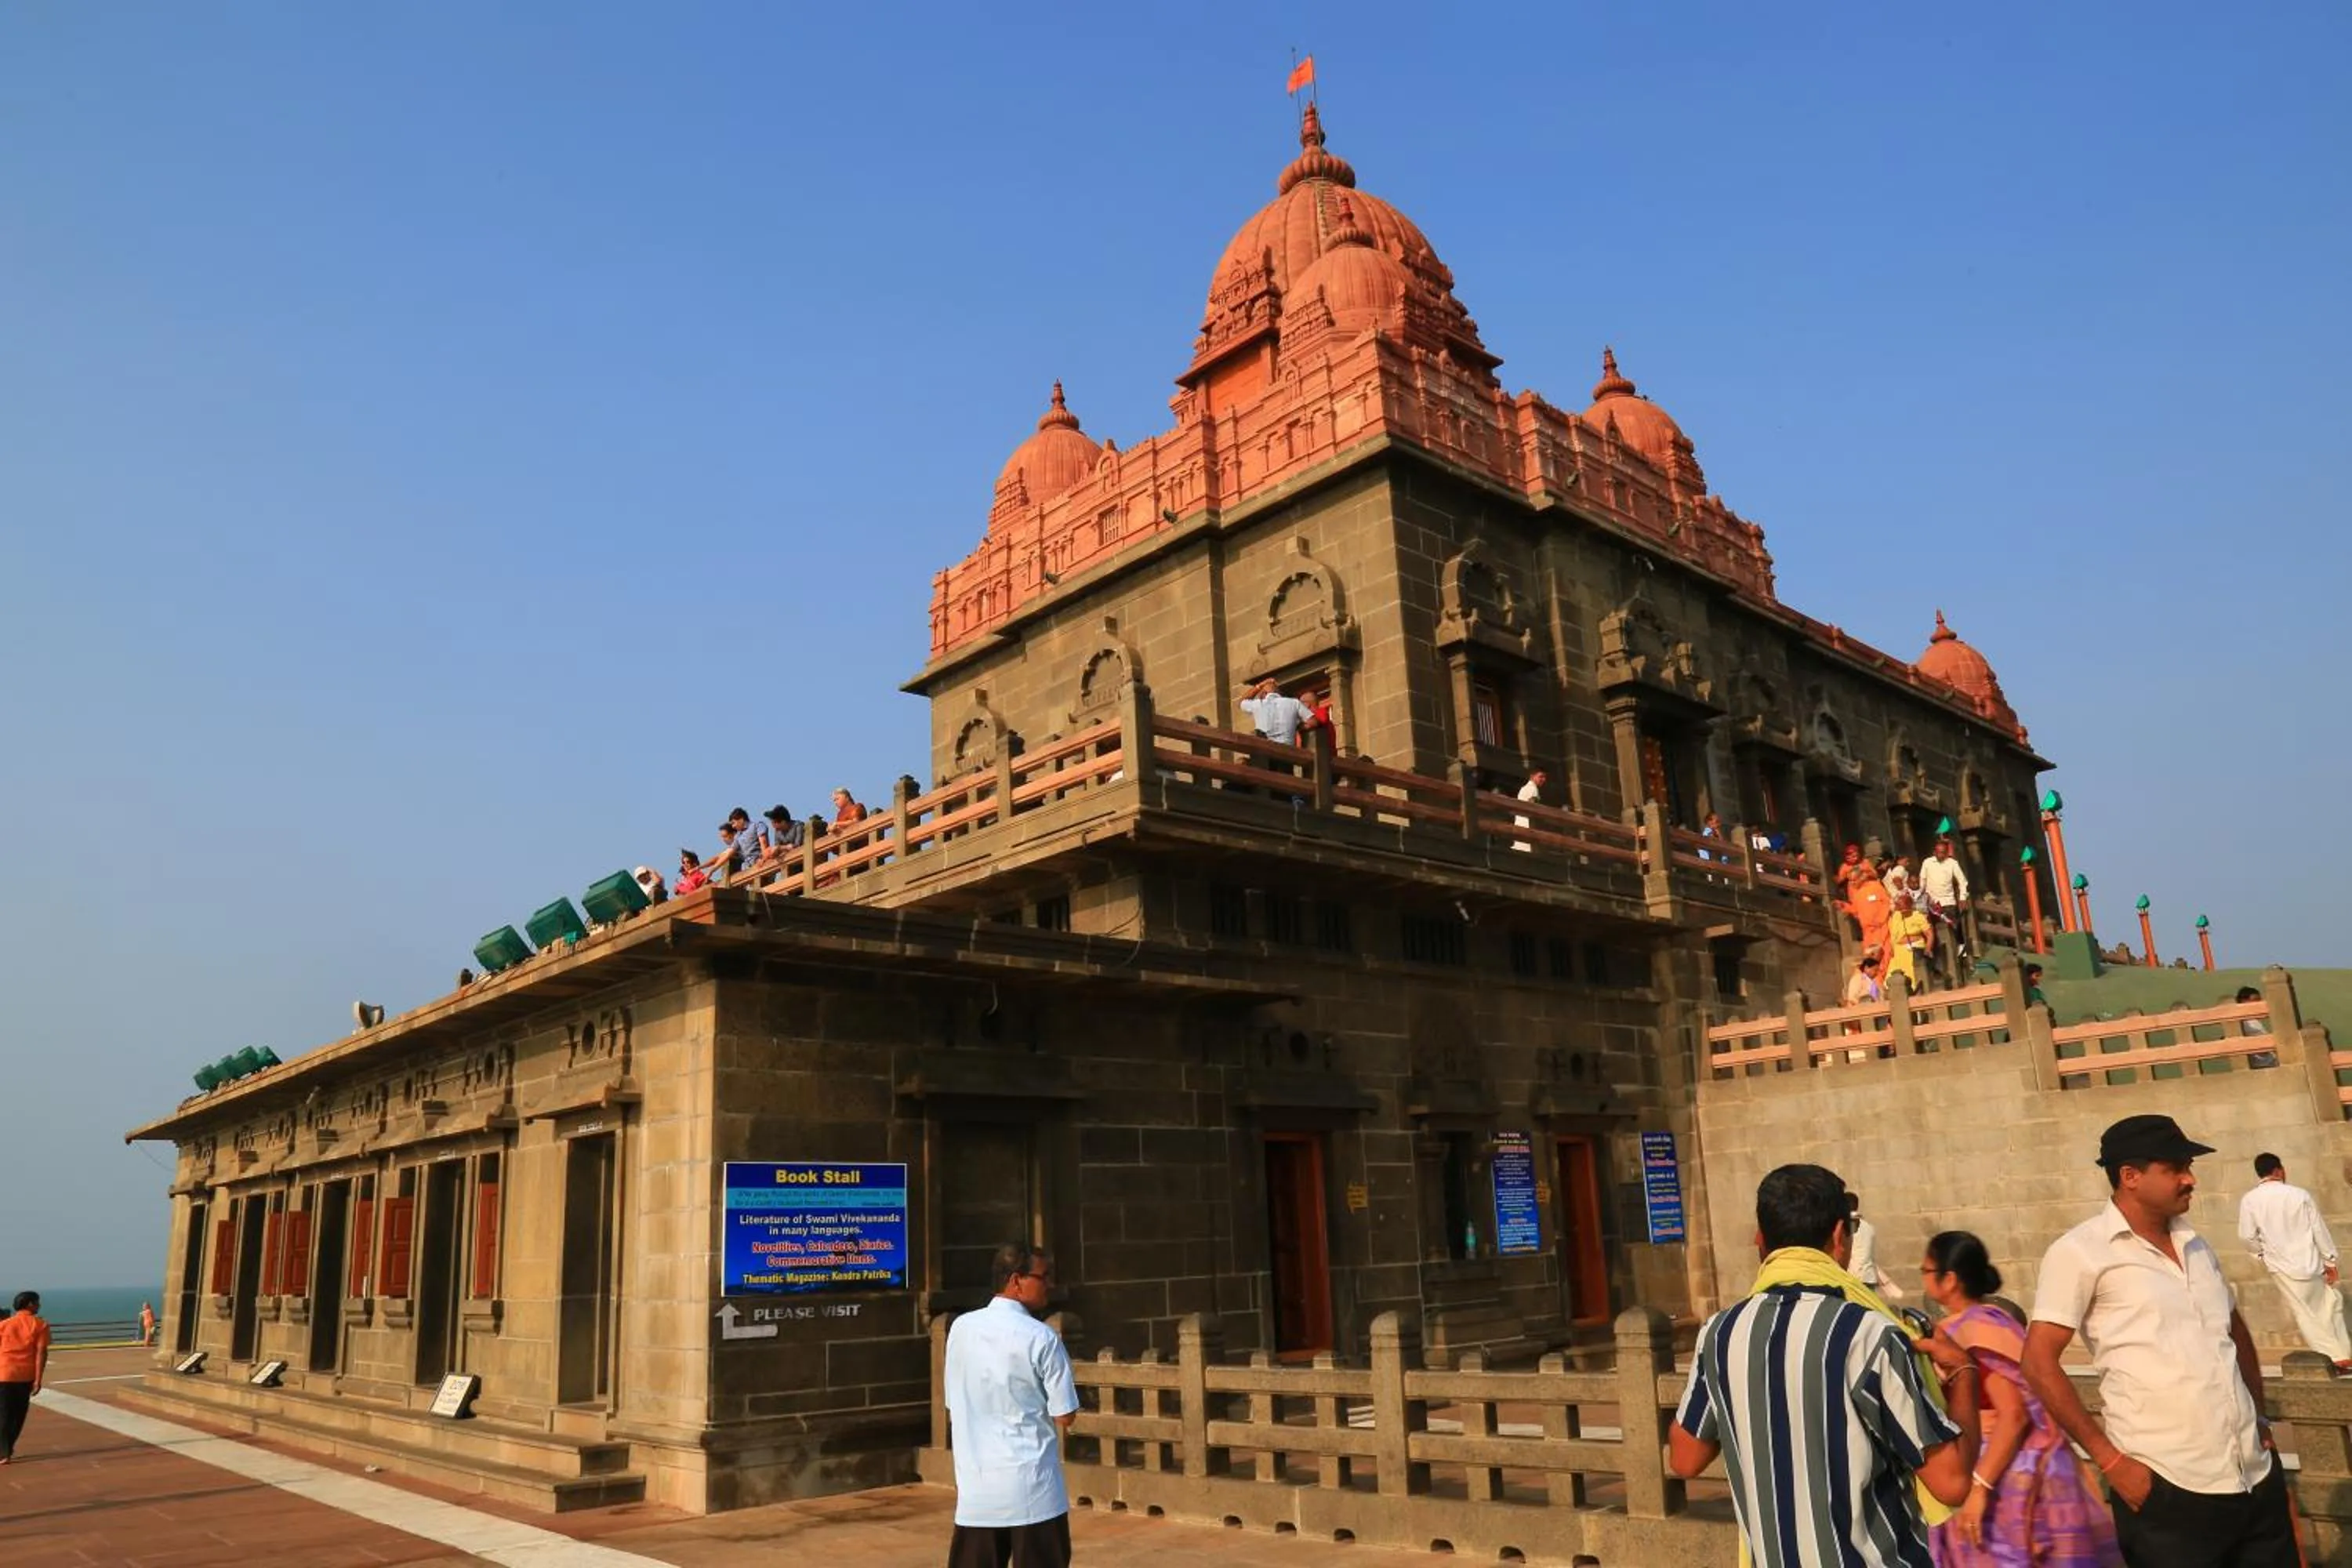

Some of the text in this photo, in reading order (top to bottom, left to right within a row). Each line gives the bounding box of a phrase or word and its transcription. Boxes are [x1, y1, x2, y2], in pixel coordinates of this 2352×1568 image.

[776, 1169, 860, 1183] Book Stall
[739, 1214, 901, 1225] Literature of Swami Vivekananda
[769, 1225, 863, 1236] in many languages.
[743, 1273, 783, 1284] Thematic
[753, 1304, 862, 1321] PLEASE VISIT
